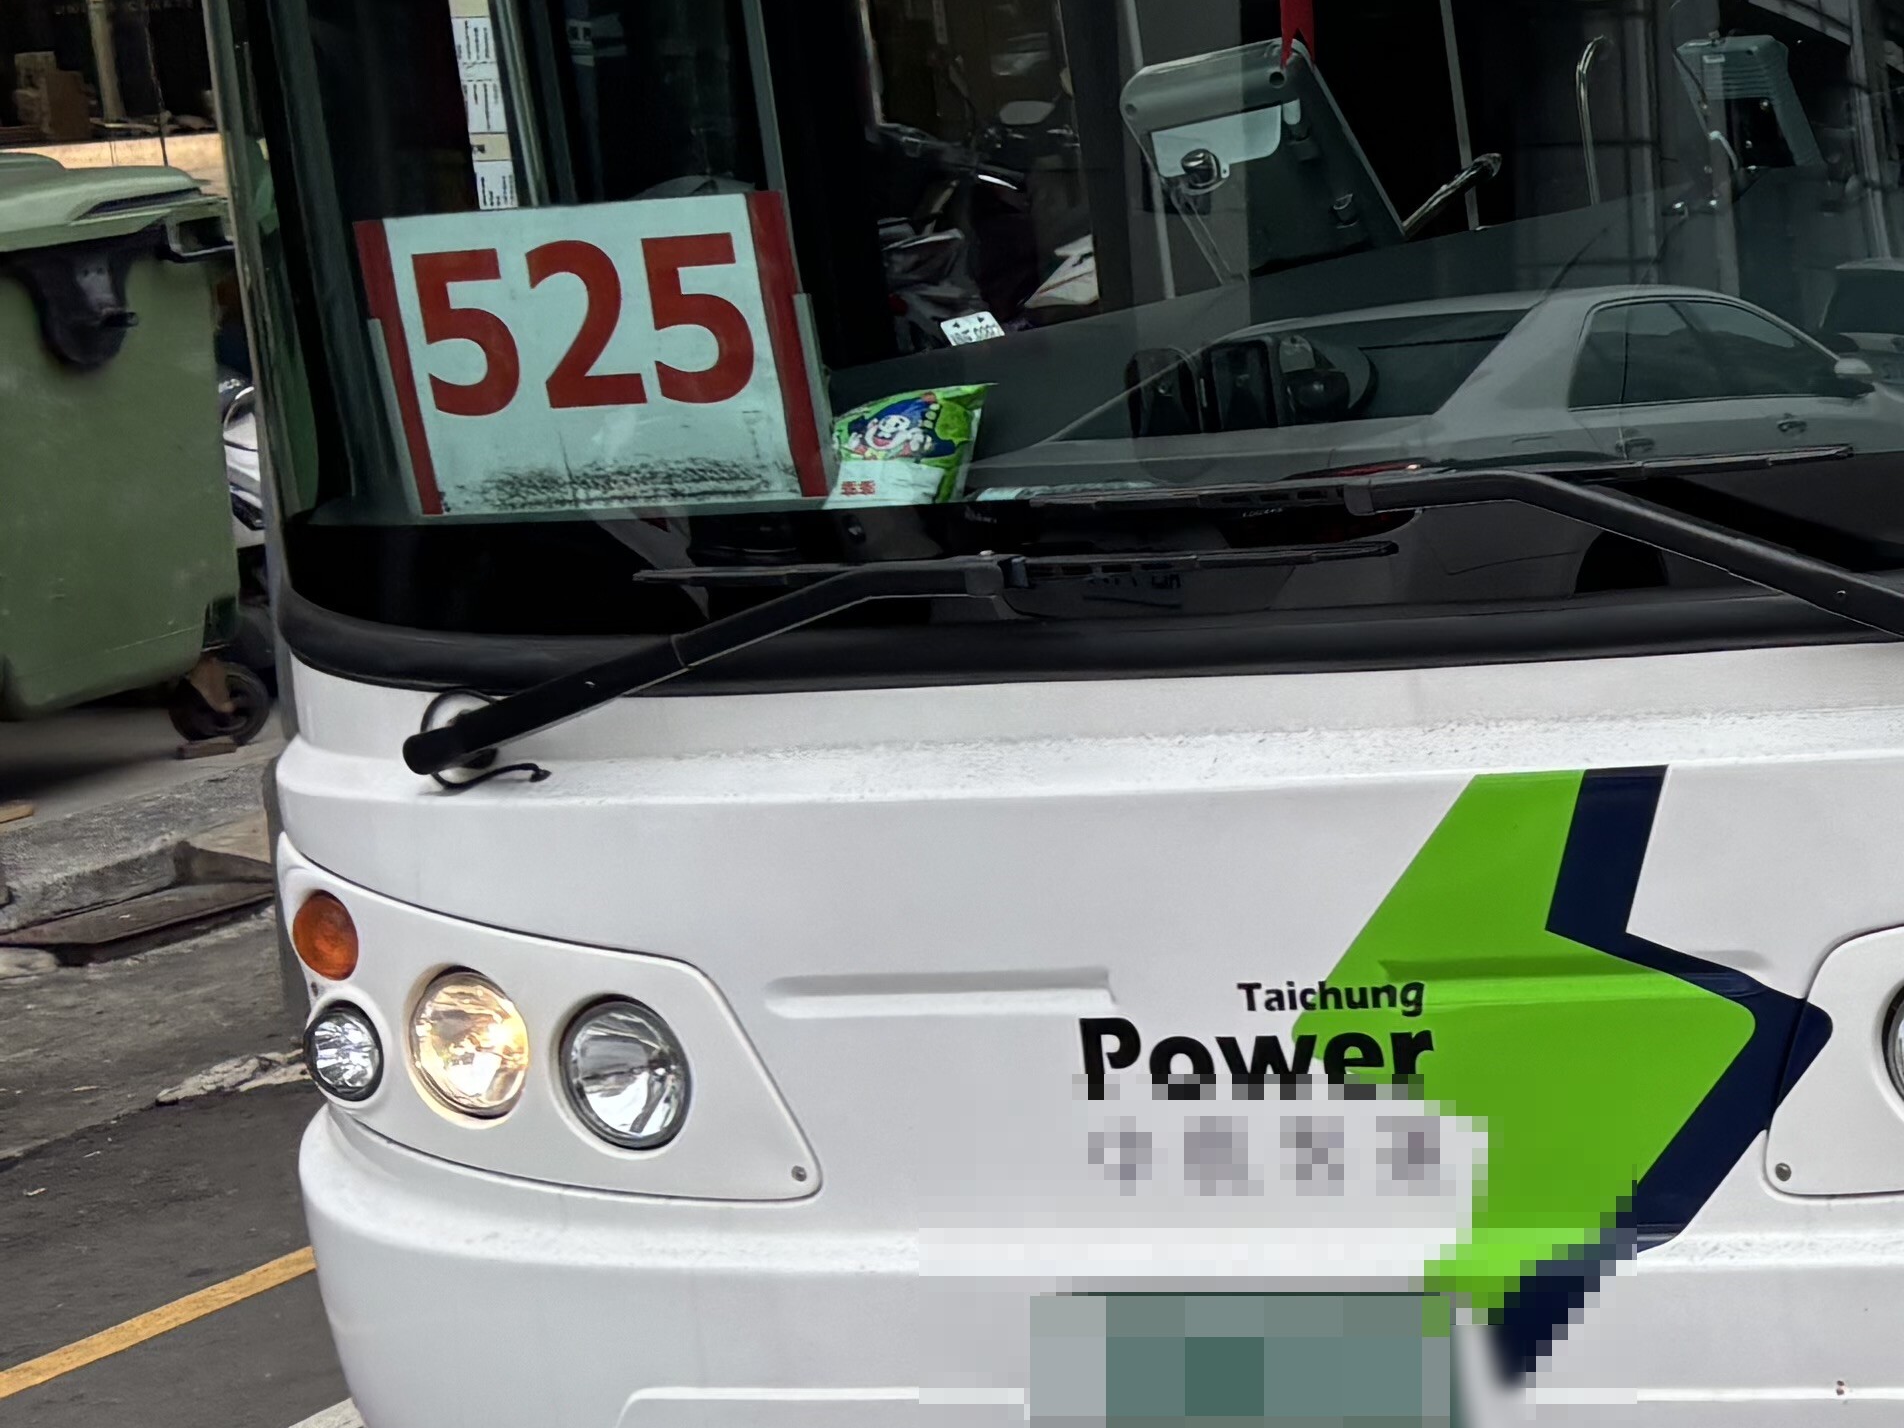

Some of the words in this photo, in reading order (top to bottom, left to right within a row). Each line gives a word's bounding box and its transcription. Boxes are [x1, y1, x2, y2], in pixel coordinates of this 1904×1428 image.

[411, 233, 756, 418] 525
[1237, 981, 1425, 1017] Taichung
[1079, 1017, 1434, 1100] Power
